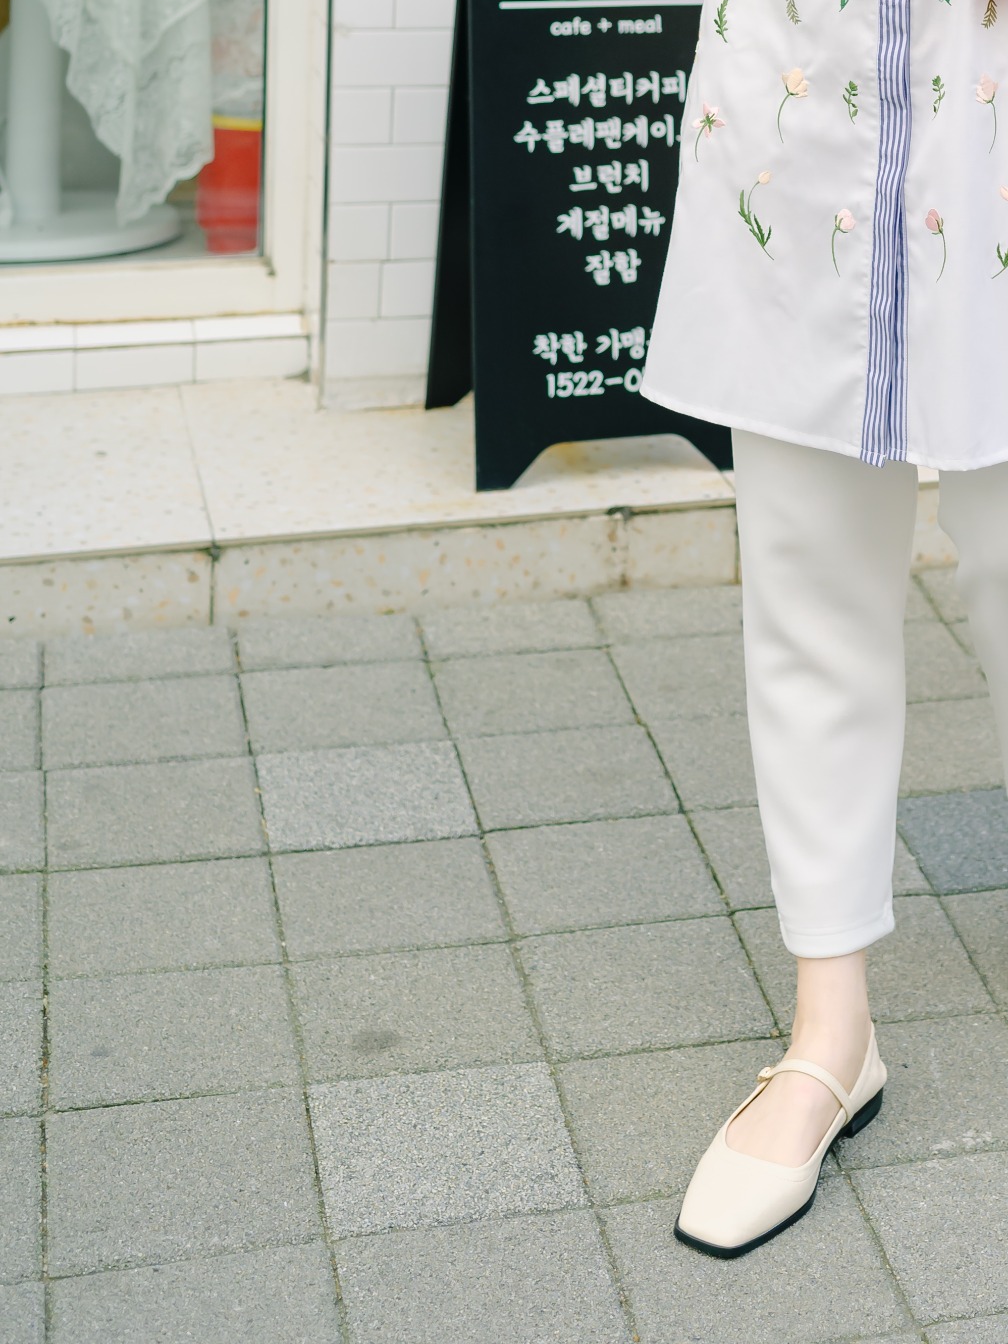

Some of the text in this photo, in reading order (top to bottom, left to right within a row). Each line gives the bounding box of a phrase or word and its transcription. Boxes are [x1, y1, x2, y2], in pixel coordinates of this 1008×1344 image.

[549, 16, 592, 37] cafe
[617, 13, 663, 35] meal
[513, 113, 681, 154] 수플레팬케이
[569, 158, 649, 194] 브런치
[556, 203, 666, 241] 계절메뉴
[584, 248, 642, 286] 잘함
[532, 326, 651, 366] 착한 가맹
[545, 367, 645, 399] 1522-0
